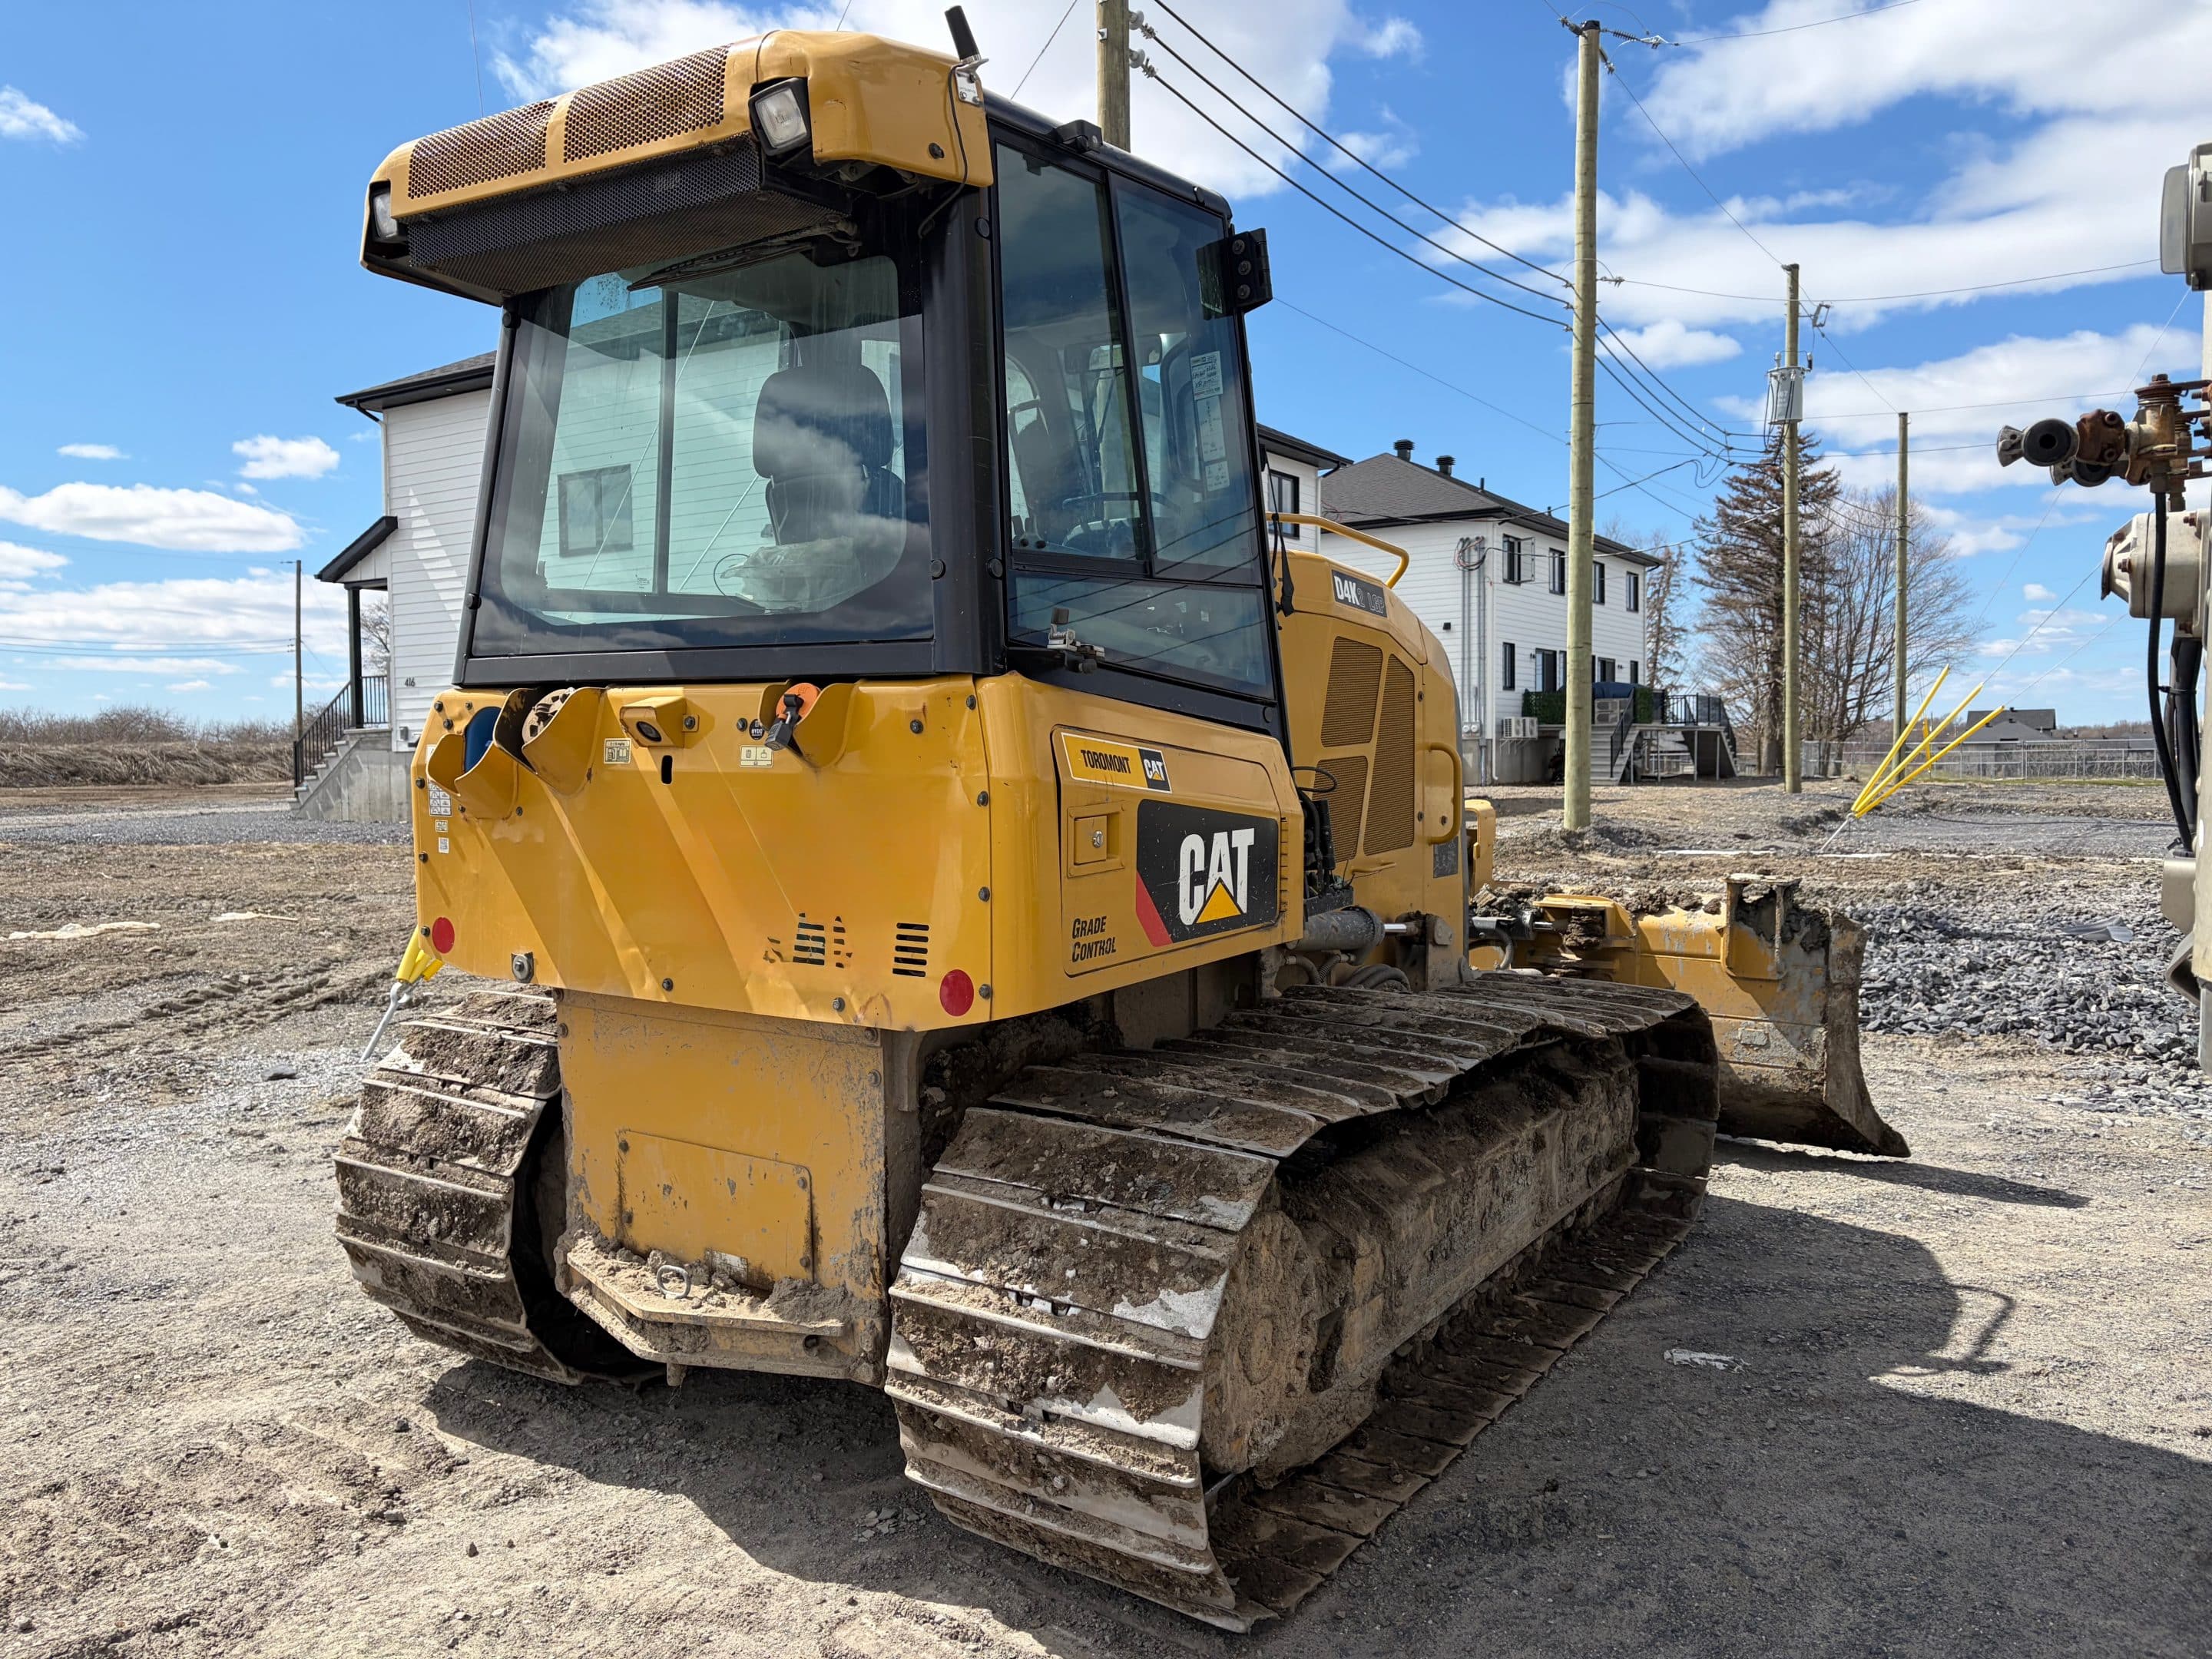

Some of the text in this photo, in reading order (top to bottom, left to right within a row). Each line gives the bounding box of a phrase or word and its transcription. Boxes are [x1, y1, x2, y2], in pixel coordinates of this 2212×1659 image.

[404, 677, 416, 687] 416
[1080, 749, 1165, 781] TOROMONT CAT
[1179, 828, 1255, 926] CAT
[1072, 916, 1107, 939] GRADE
[1072, 937, 1116, 962] CONTROL
